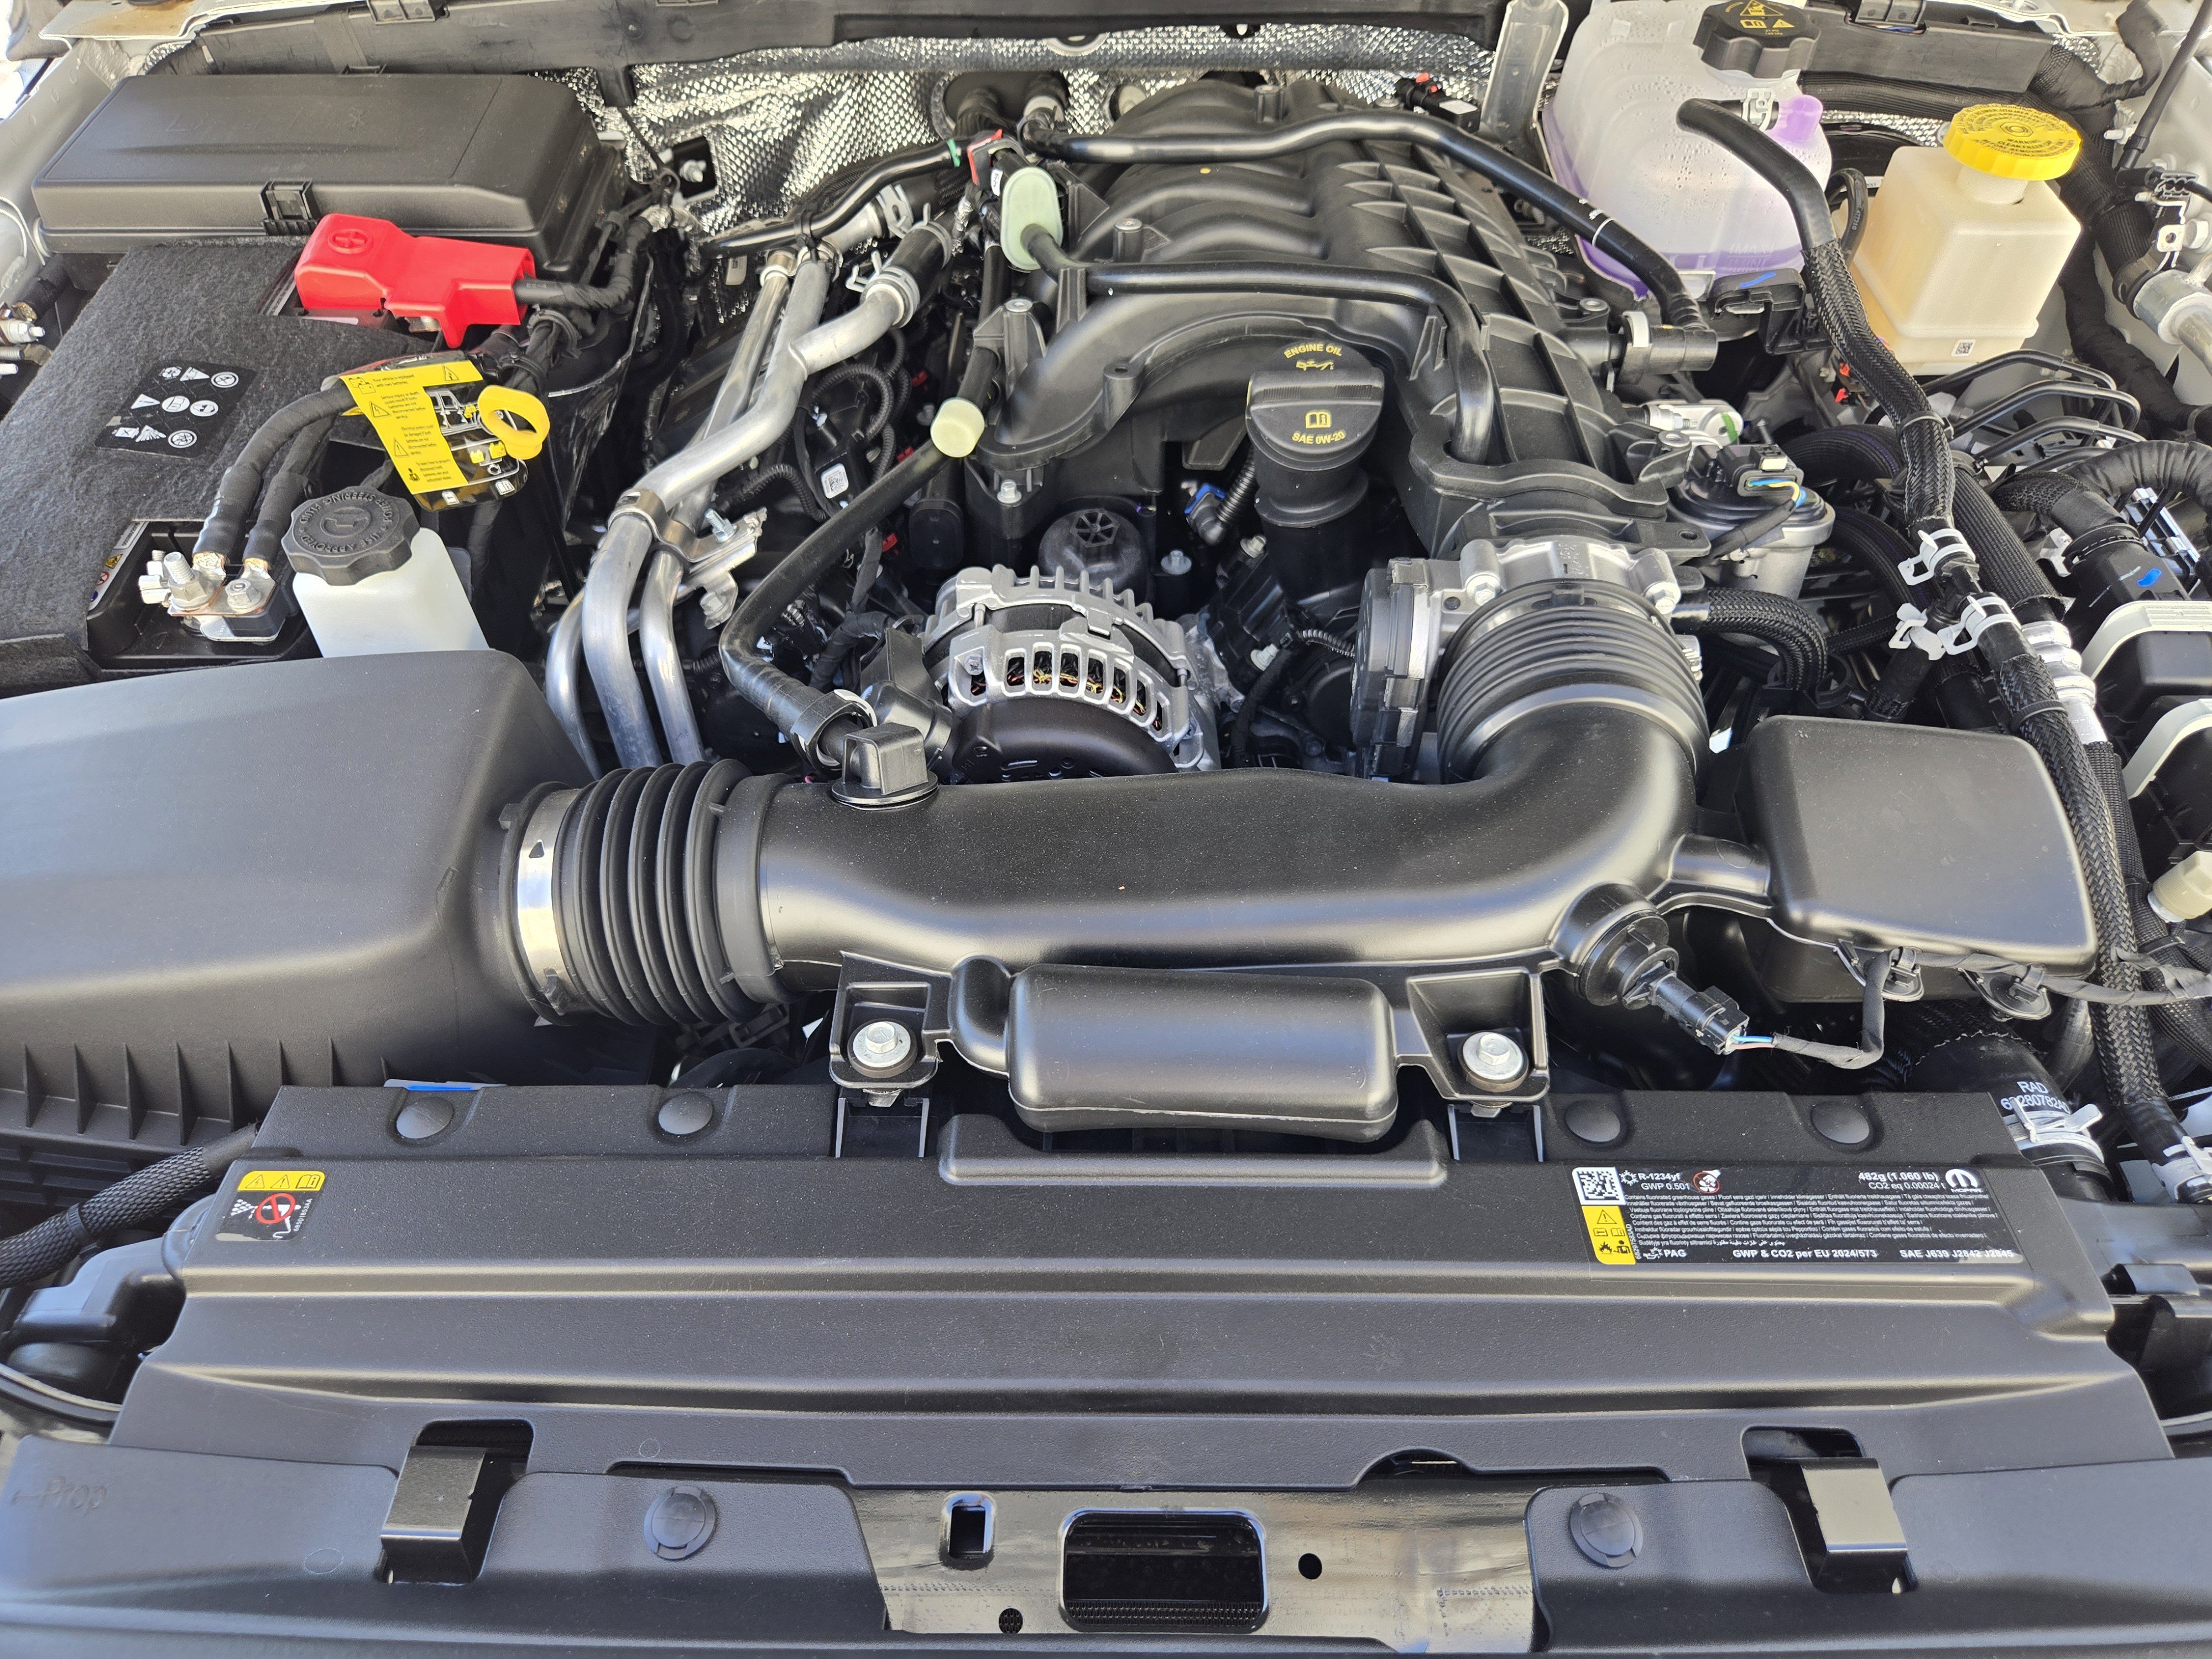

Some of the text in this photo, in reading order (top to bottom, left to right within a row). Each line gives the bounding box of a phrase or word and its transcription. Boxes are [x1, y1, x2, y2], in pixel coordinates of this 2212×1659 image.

[1284, 343, 1343, 358] ENGINE OIL
[1292, 431, 1346, 445] SAE 0W-20
[322, 492, 376, 505] STEERING
[299, 503, 322, 524] FLUID
[301, 535, 357, 552] APPROVED
[360, 531, 382, 547] USE
[2017, 1081, 2048, 1093] RAD
[2000, 1094, 2072, 1115] 6280782AD
[1638, 1172, 1681, 1181] R-1234yf
[1858, 1172, 1939, 1182] 482g (1.060 lb)
[1663, 1249, 1687, 1258] PAG
[1733, 1249, 1877, 1260] GWP & CO2 per EU 2024/573
[1899, 1250, 1923, 1258] SAE
[39, 1475, 107, 1518] Prop
